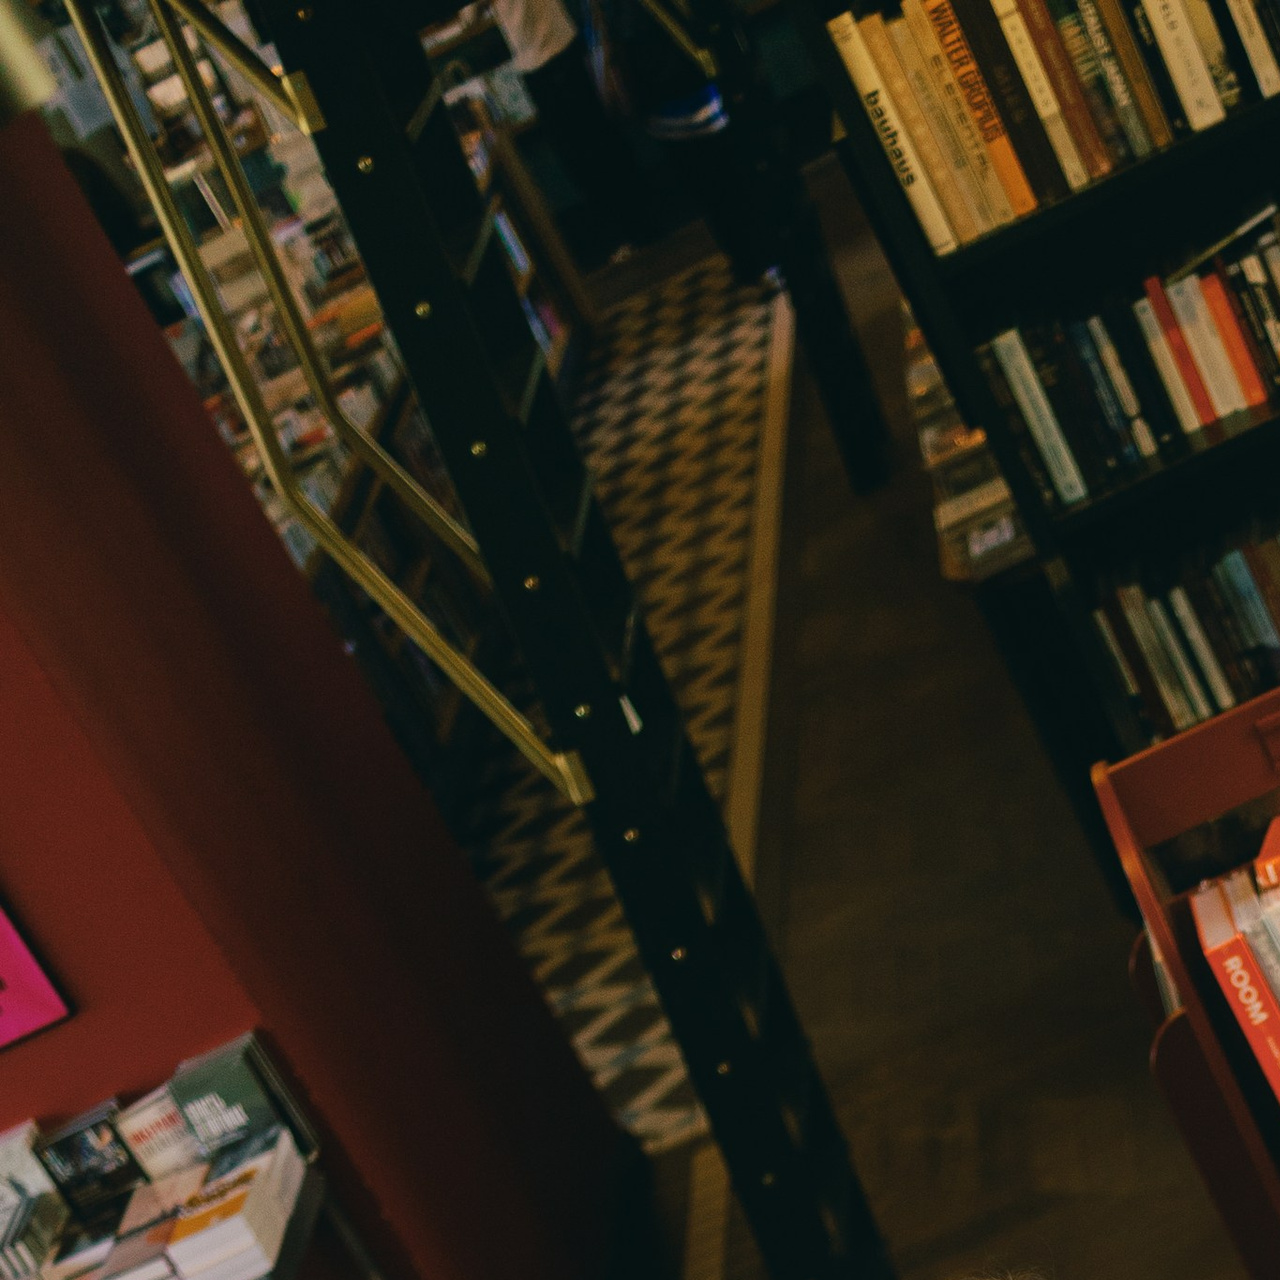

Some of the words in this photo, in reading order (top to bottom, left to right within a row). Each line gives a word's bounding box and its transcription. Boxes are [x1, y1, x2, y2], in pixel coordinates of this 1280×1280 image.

[929, 4, 973, 79] WALTER
[960, 68, 1002, 143] GROPIUS
[863, 90, 915, 188] bauhaus
[1222, 954, 1268, 1026] ROOM
